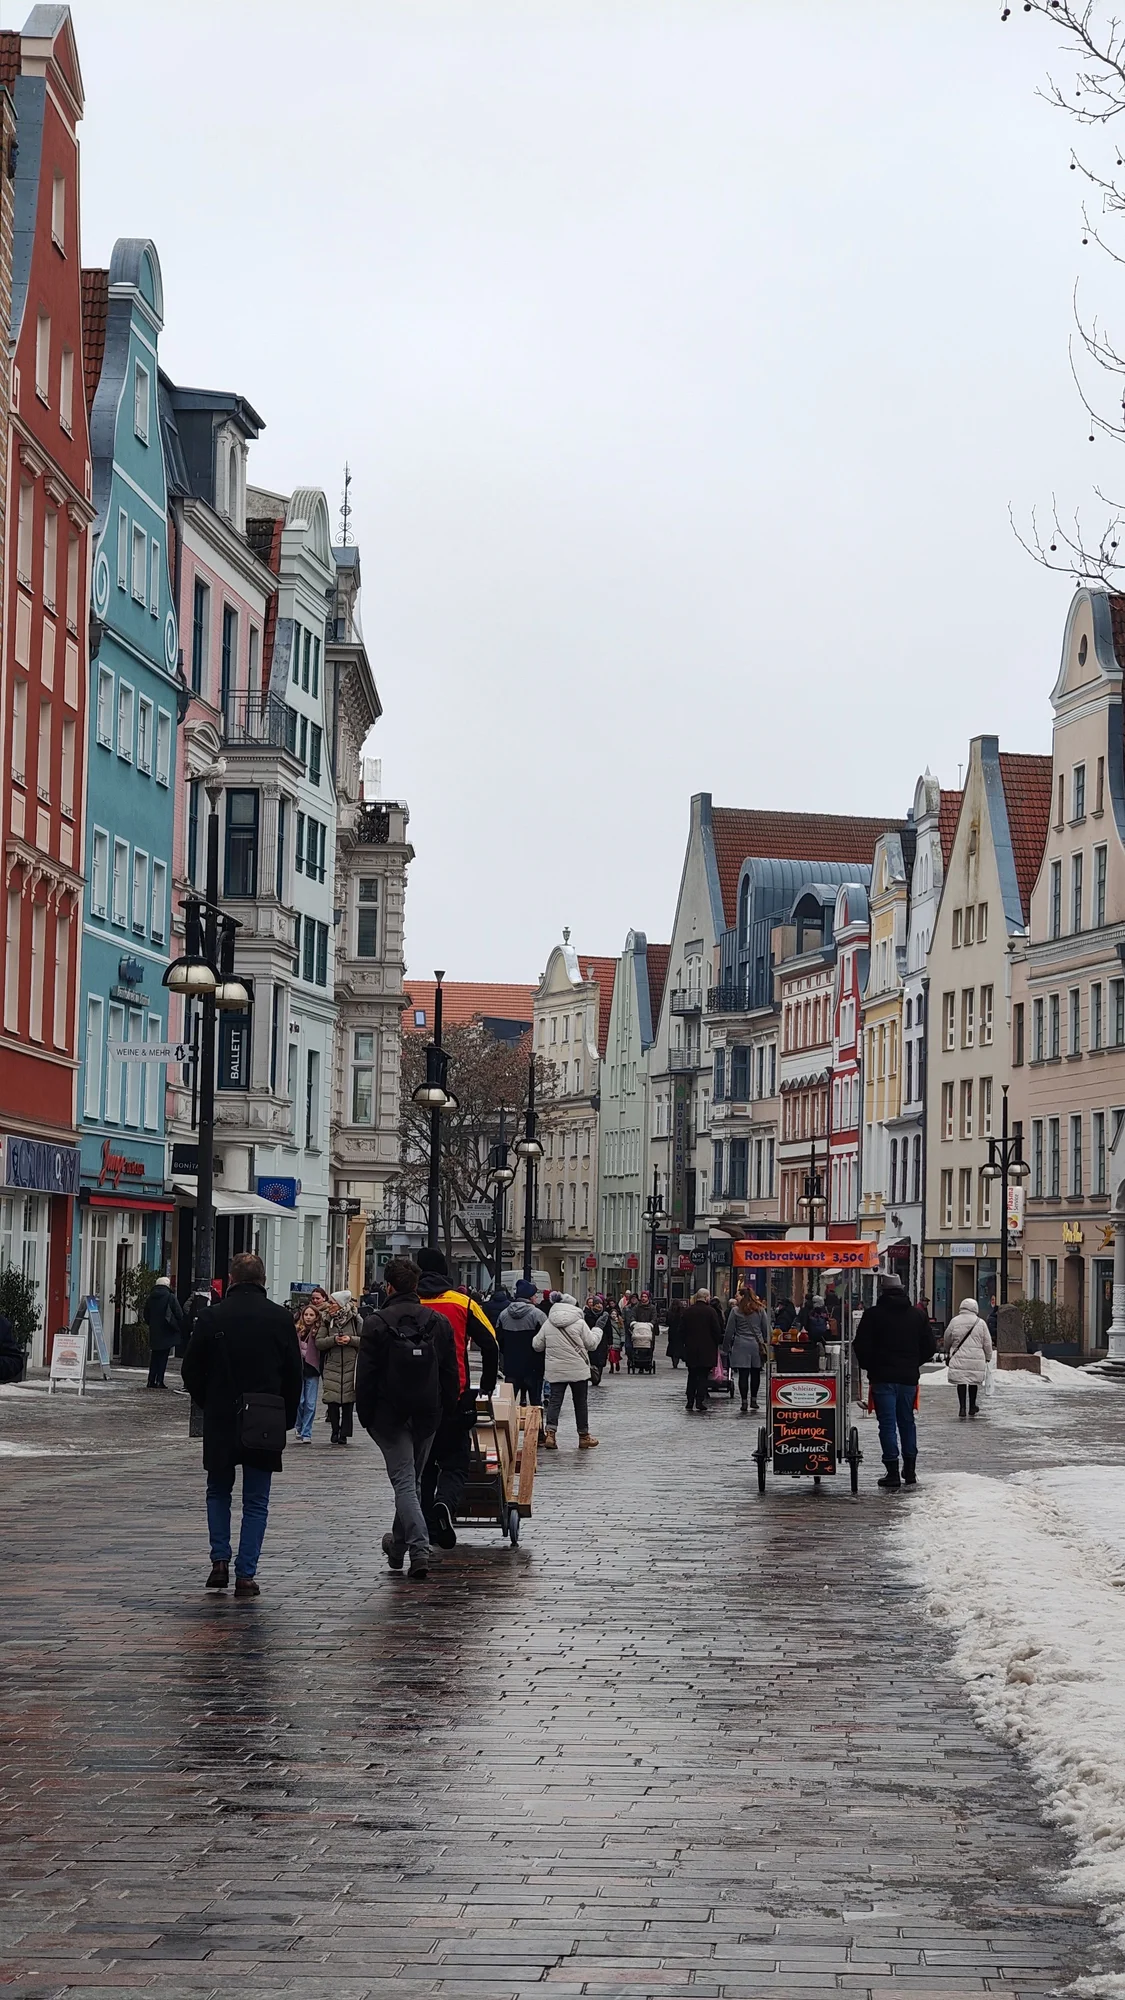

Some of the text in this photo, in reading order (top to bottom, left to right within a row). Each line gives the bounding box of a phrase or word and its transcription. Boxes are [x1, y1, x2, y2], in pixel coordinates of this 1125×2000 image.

[116, 1048, 171, 1057] WEINE & MEHR
[230, 1029, 241, 1080] BALLETT
[675, 1102, 684, 1195] Hopfen Markt
[744, 1250, 826, 1262] Rostbratwurst
[832, 1252, 864, 1264] 3,50€
[774, 1424, 828, 1440] Thüringer
[775, 1443, 830, 1455] Bratwurst
